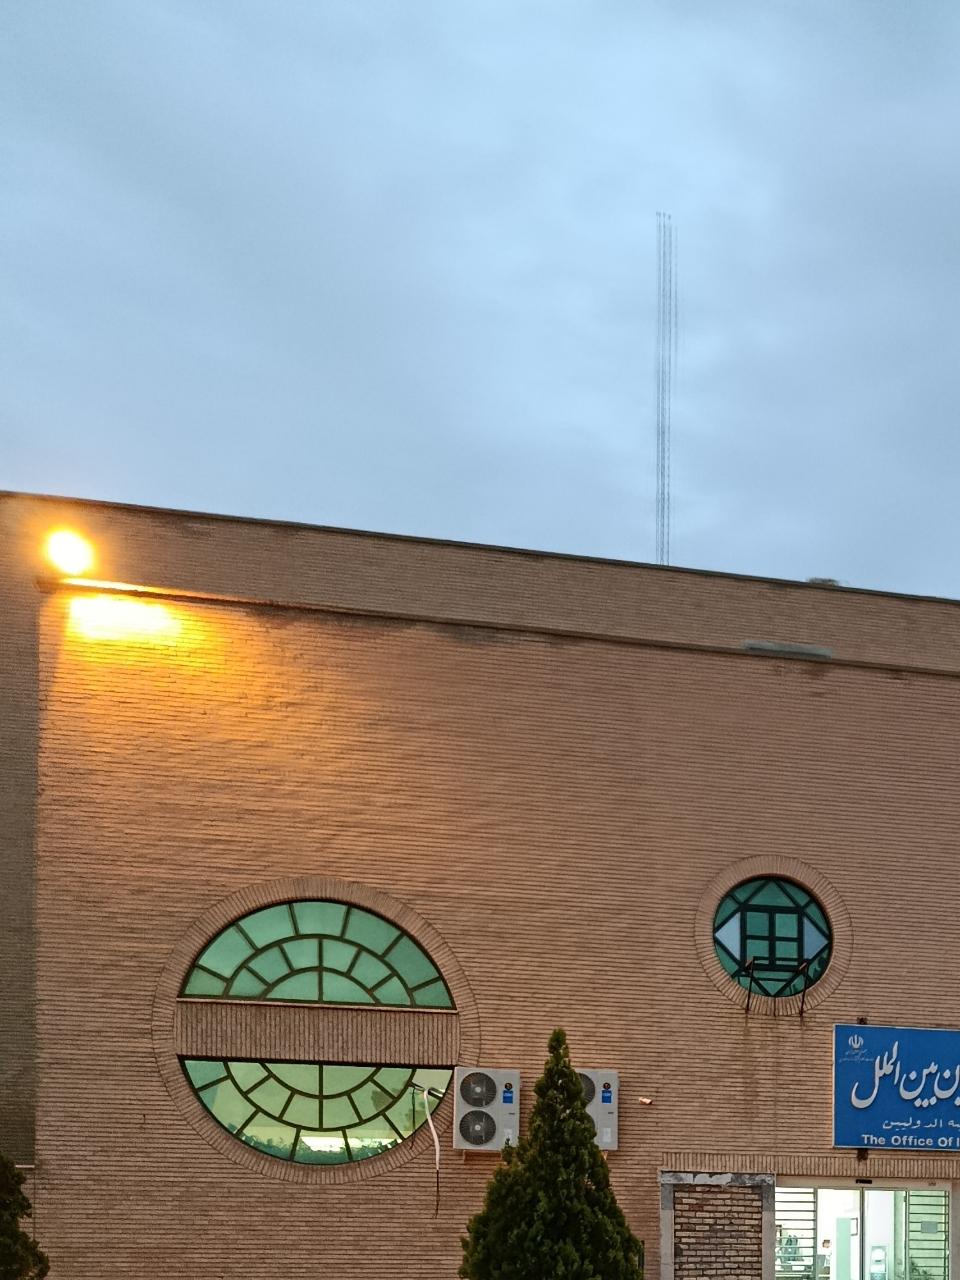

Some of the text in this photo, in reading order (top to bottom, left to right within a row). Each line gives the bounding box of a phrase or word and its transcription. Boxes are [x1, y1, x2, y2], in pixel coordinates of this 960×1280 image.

[850, 1041, 901, 1109] الملل
[899, 1061, 938, 1107] بین
[861, 1134, 886, 1145] The
[891, 1135, 934, 1147] Office
[938, 1136, 954, 1148] Of
